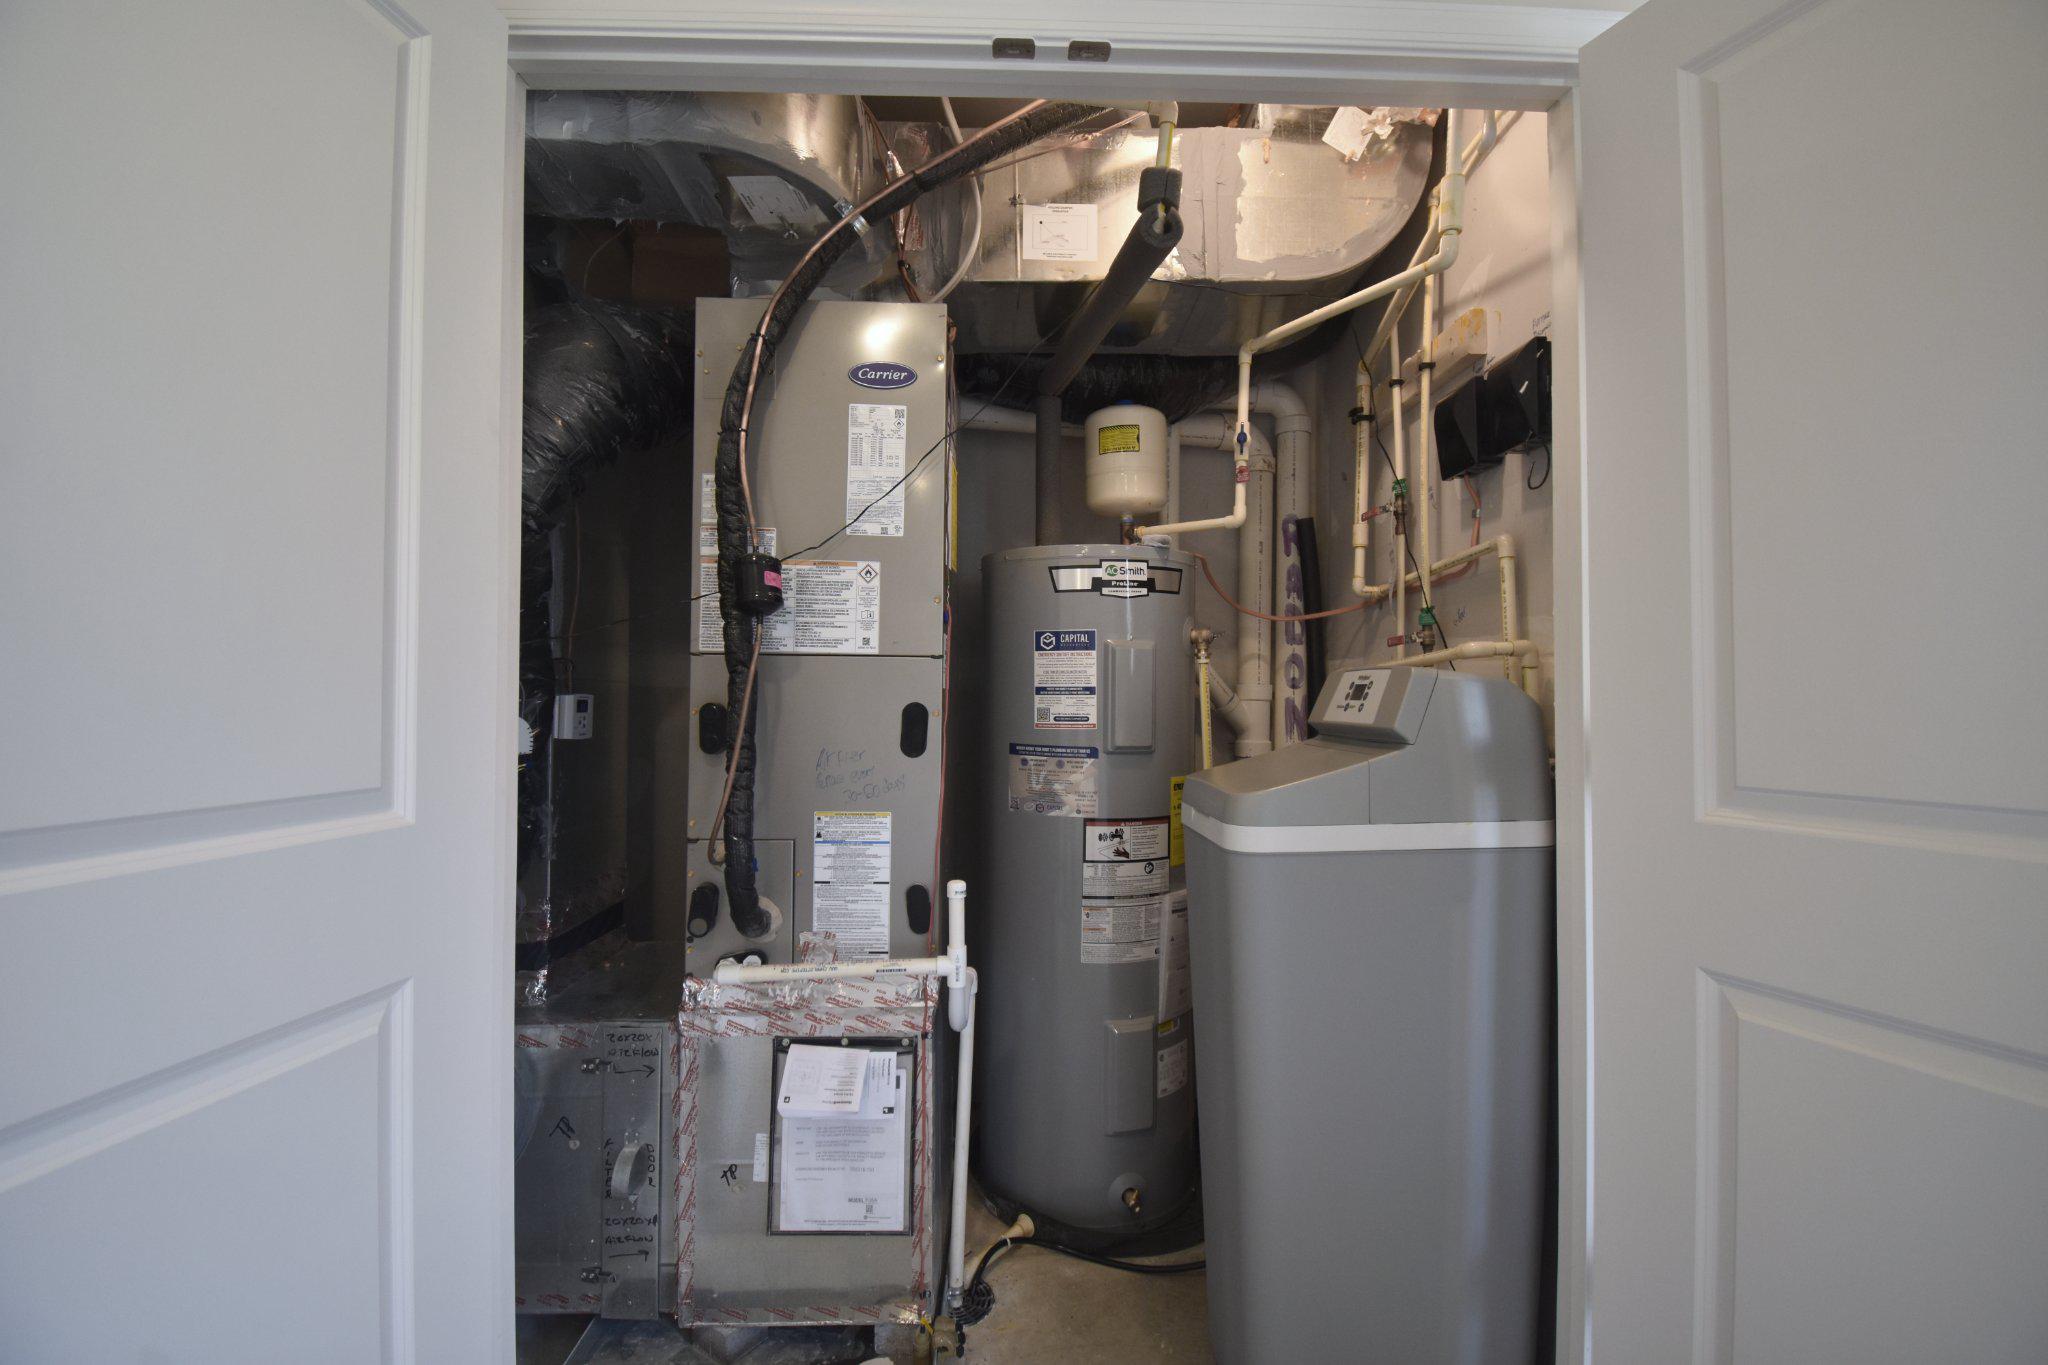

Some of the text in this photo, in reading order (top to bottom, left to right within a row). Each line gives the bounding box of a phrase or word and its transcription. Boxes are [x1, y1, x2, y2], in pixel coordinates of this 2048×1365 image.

[858, 367, 908, 380] Carrier
[1119, 566, 1145, 575] Smith
[1281, 513, 1308, 742] RADON
[1060, 633, 1090, 643] CAPITAL
